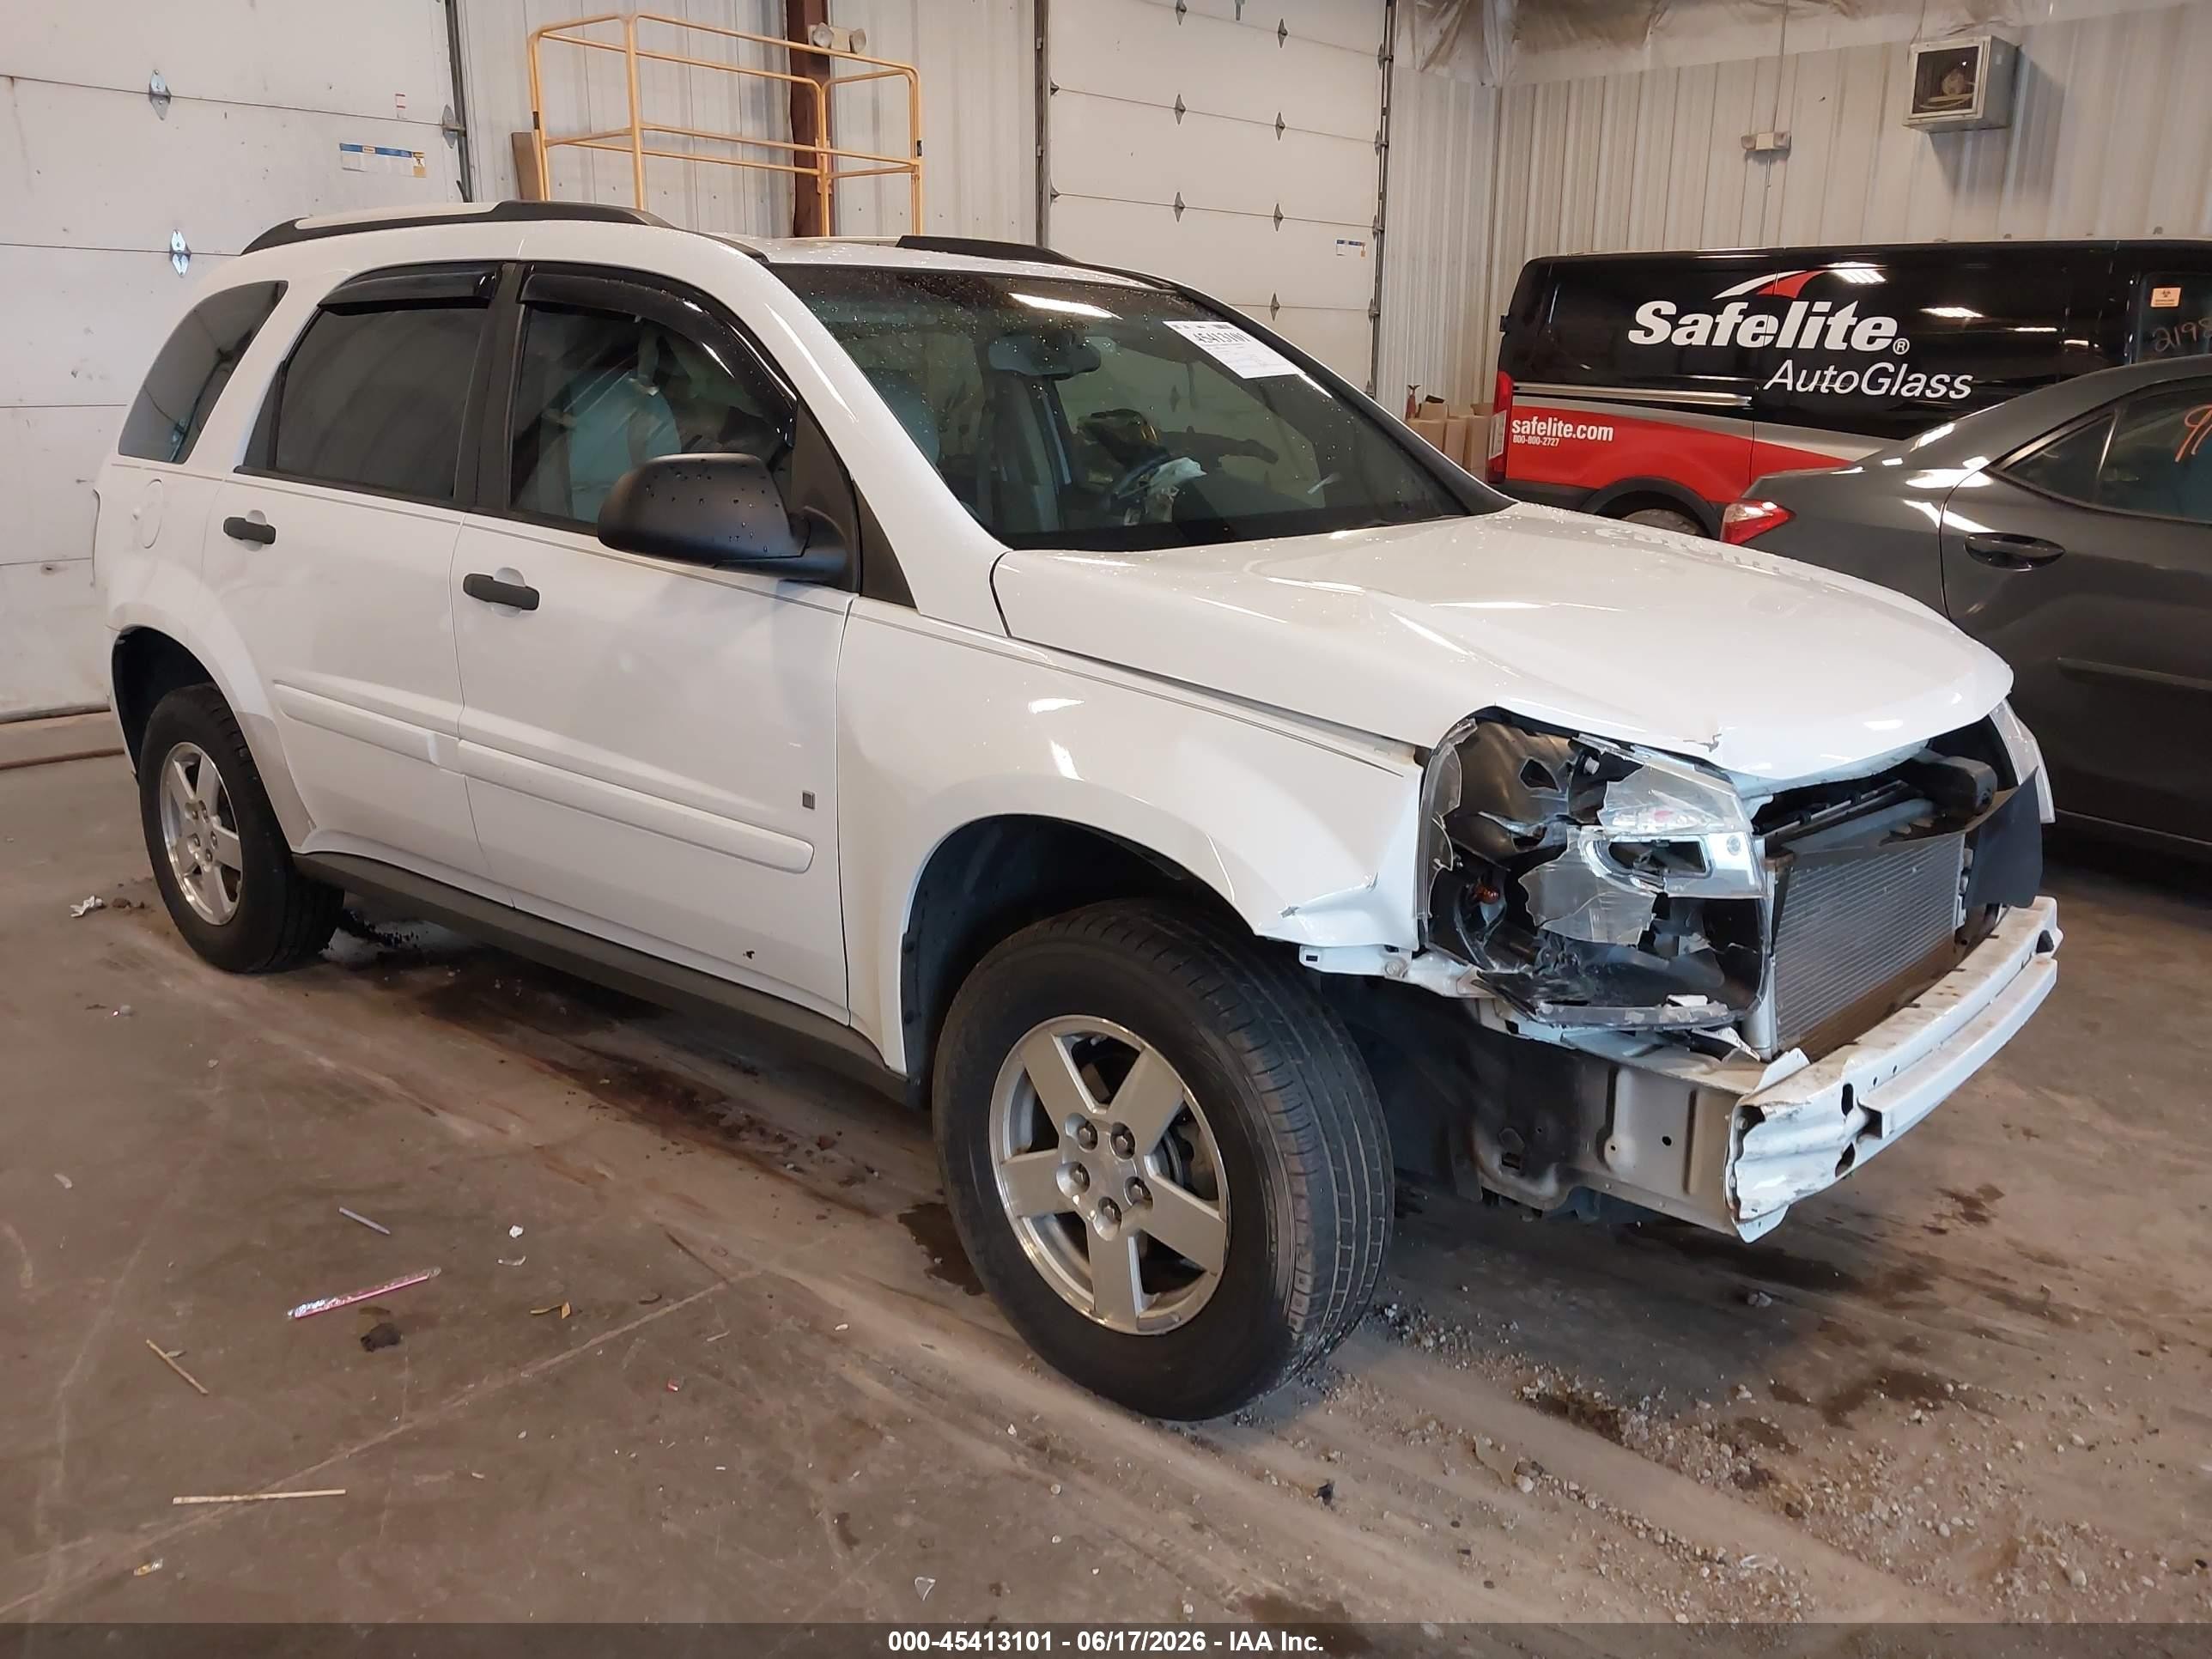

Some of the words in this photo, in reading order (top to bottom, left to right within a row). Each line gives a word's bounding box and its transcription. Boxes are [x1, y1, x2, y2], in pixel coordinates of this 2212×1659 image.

[1763, 359, 1973, 399] AutoGlass
[1511, 416, 1613, 441] safelite.com
[1512, 434, 1560, 447] 800-800-2727
